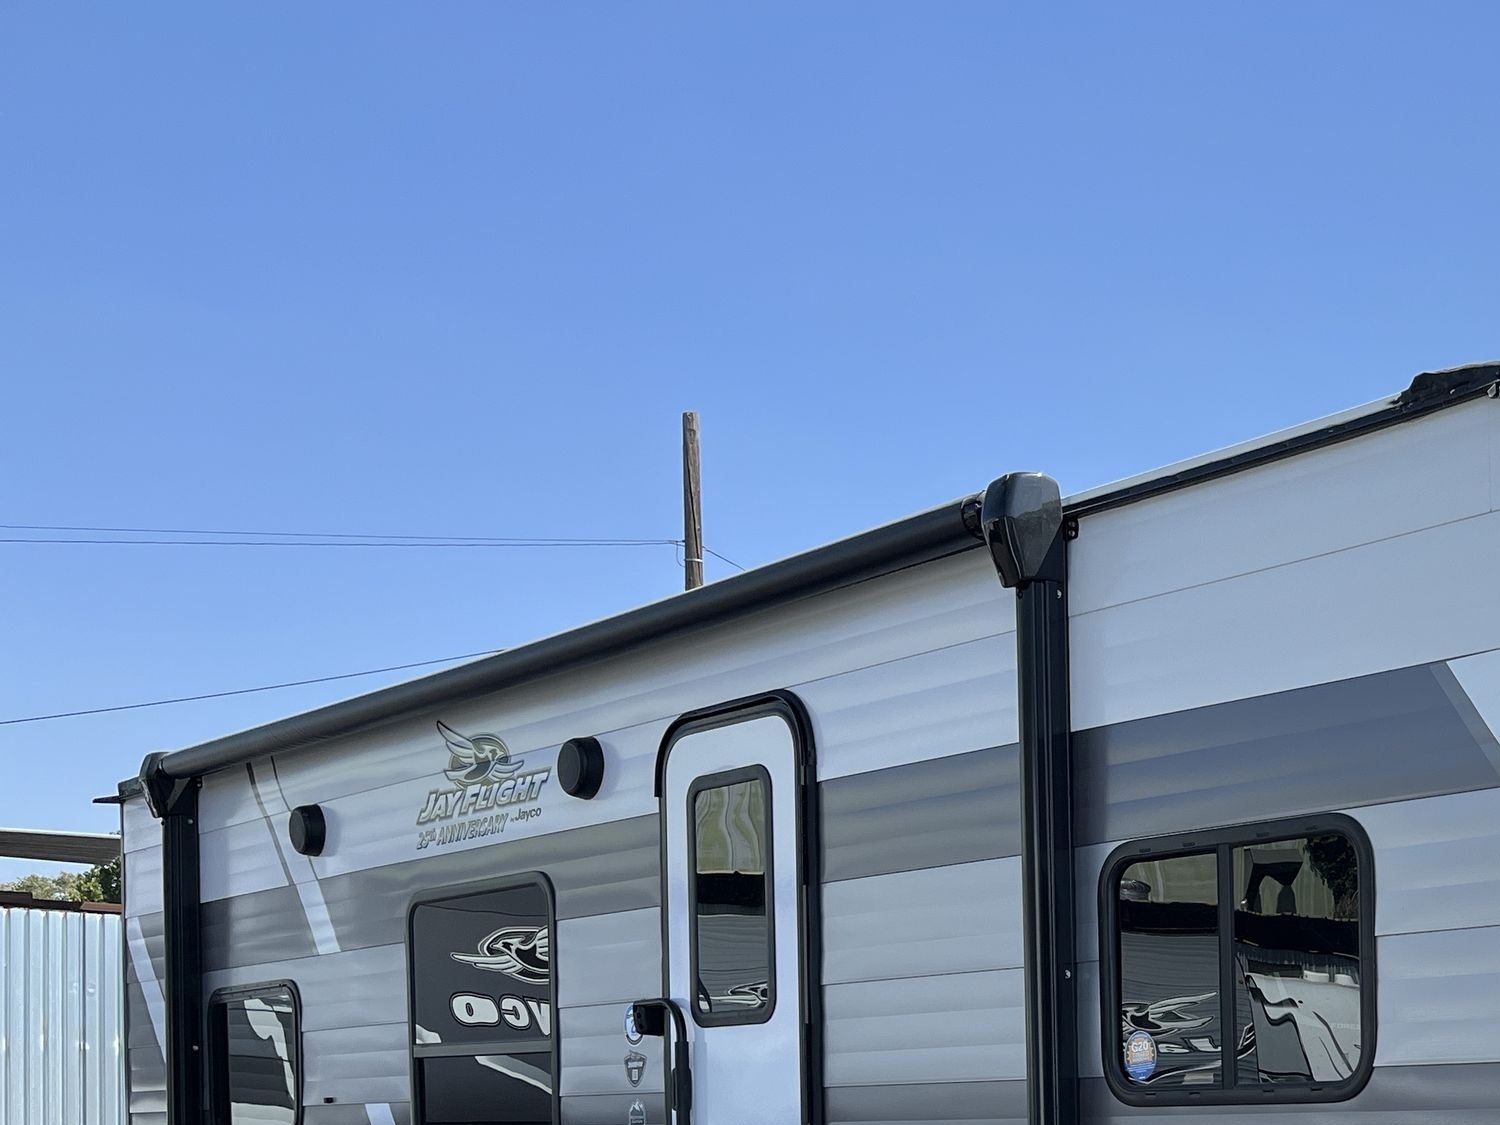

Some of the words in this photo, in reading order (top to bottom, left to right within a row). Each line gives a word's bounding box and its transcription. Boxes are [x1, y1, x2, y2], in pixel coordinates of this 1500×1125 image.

[416, 790, 463, 825] JAY
[459, 767, 552, 816] FLIGHT
[436, 813, 509, 846] ANNIVERSARY
[515, 807, 542, 822] Jayco
[1131, 1041, 1149, 1053] G20
